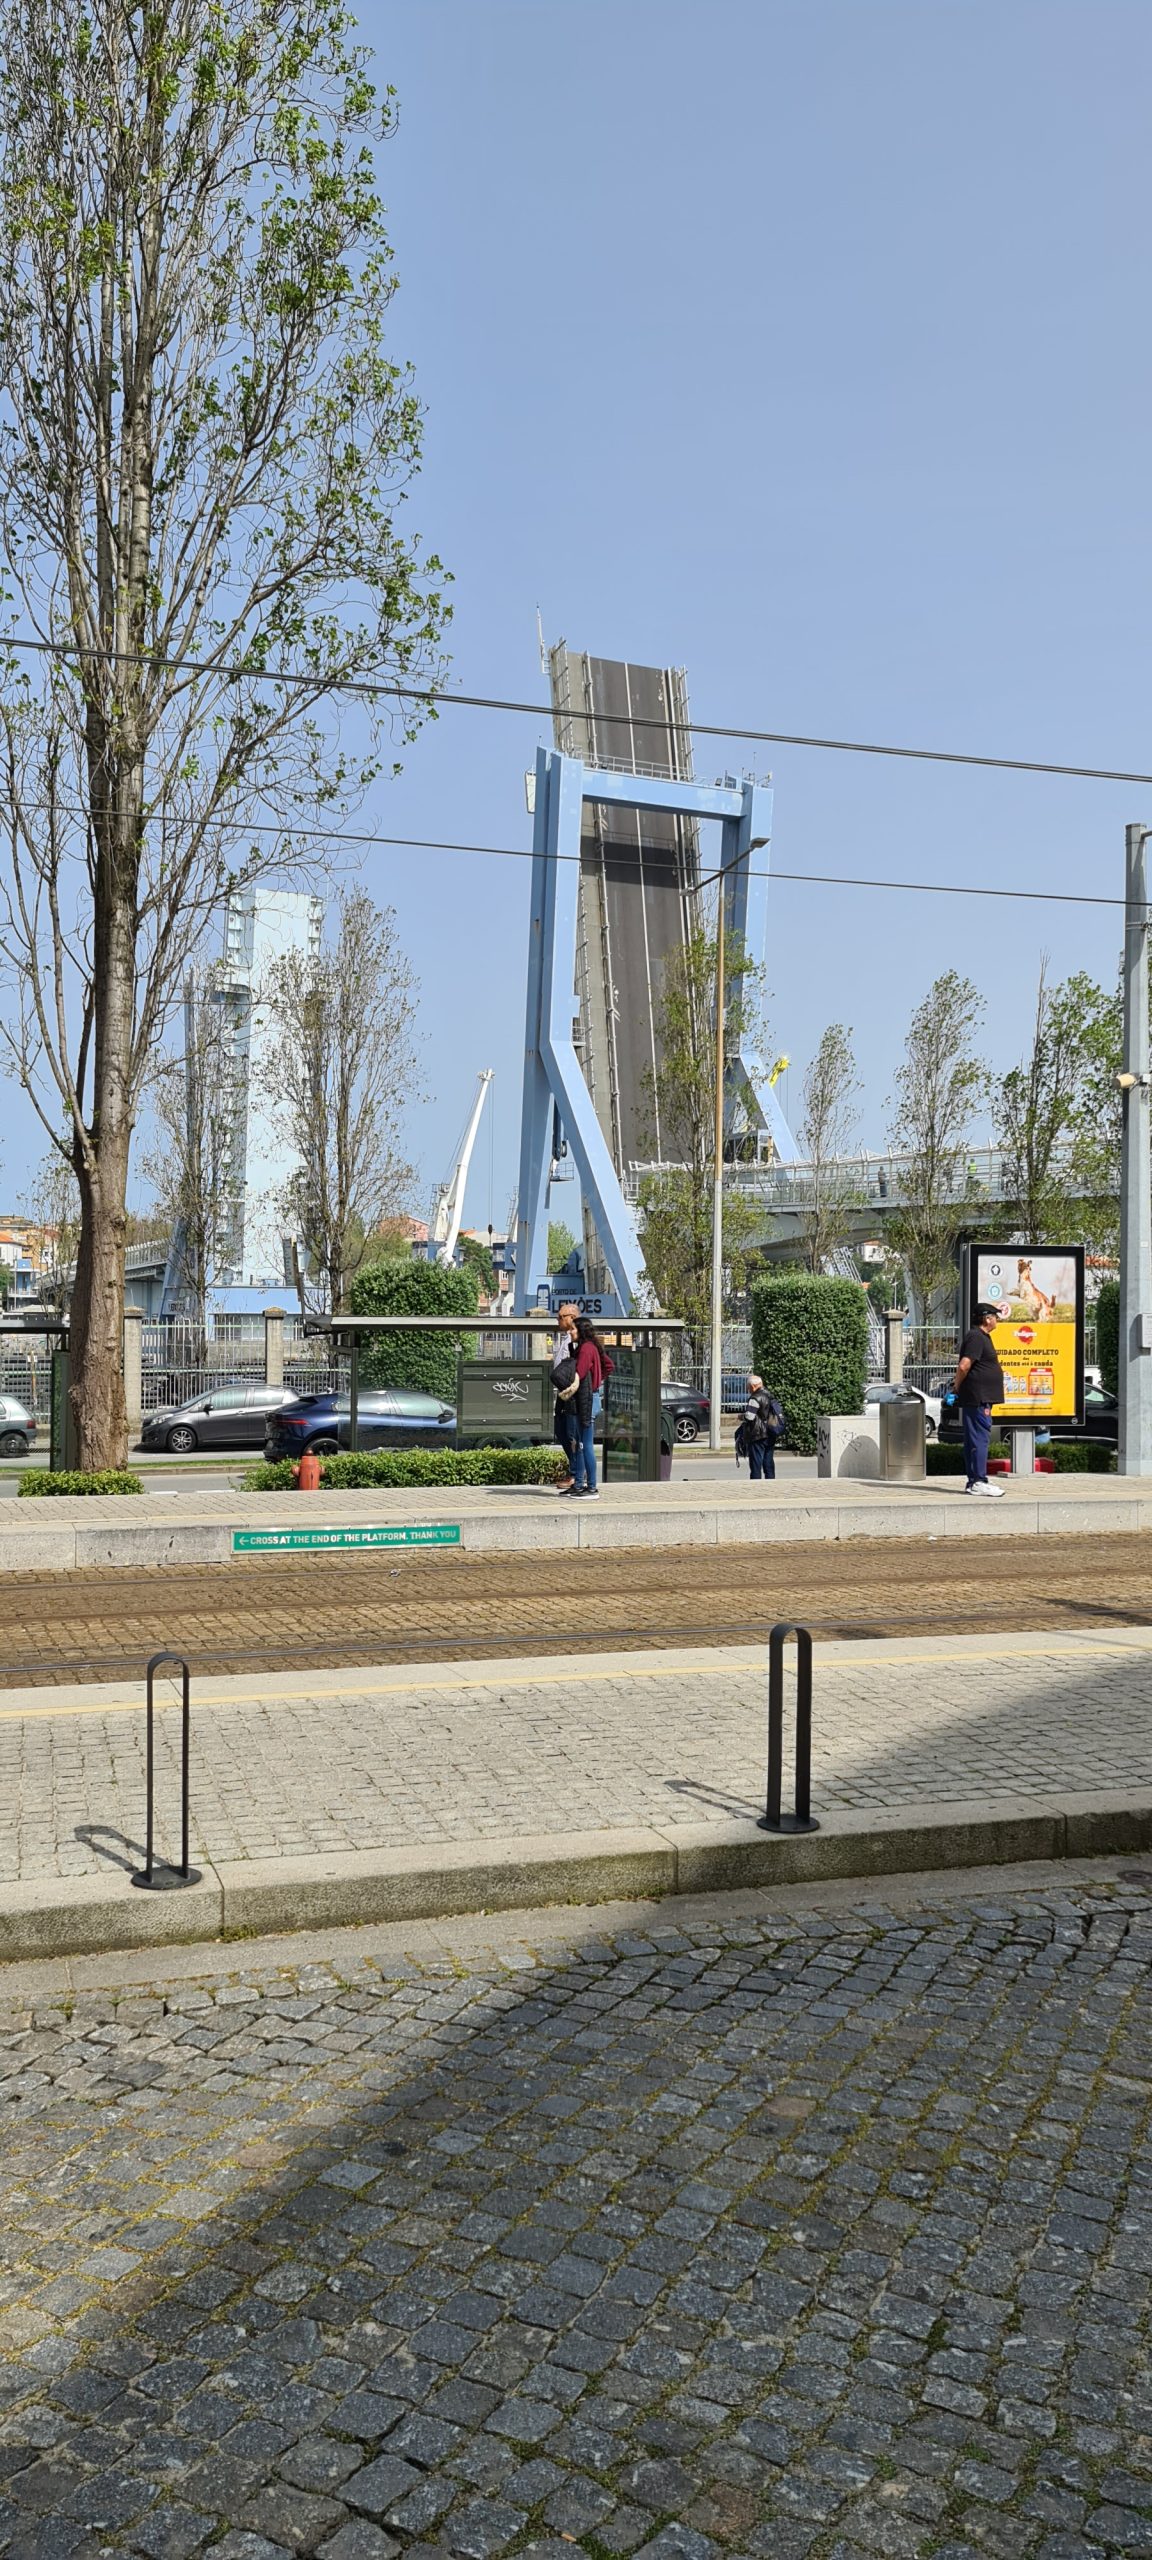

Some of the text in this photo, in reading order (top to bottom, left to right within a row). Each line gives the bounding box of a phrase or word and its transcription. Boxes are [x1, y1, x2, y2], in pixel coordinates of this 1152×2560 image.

[552, 1297, 602, 1314] LEÕES
[250, 1530, 456, 1545] CROSS AT THE END OF THE PLATFORM. THANK YOU
